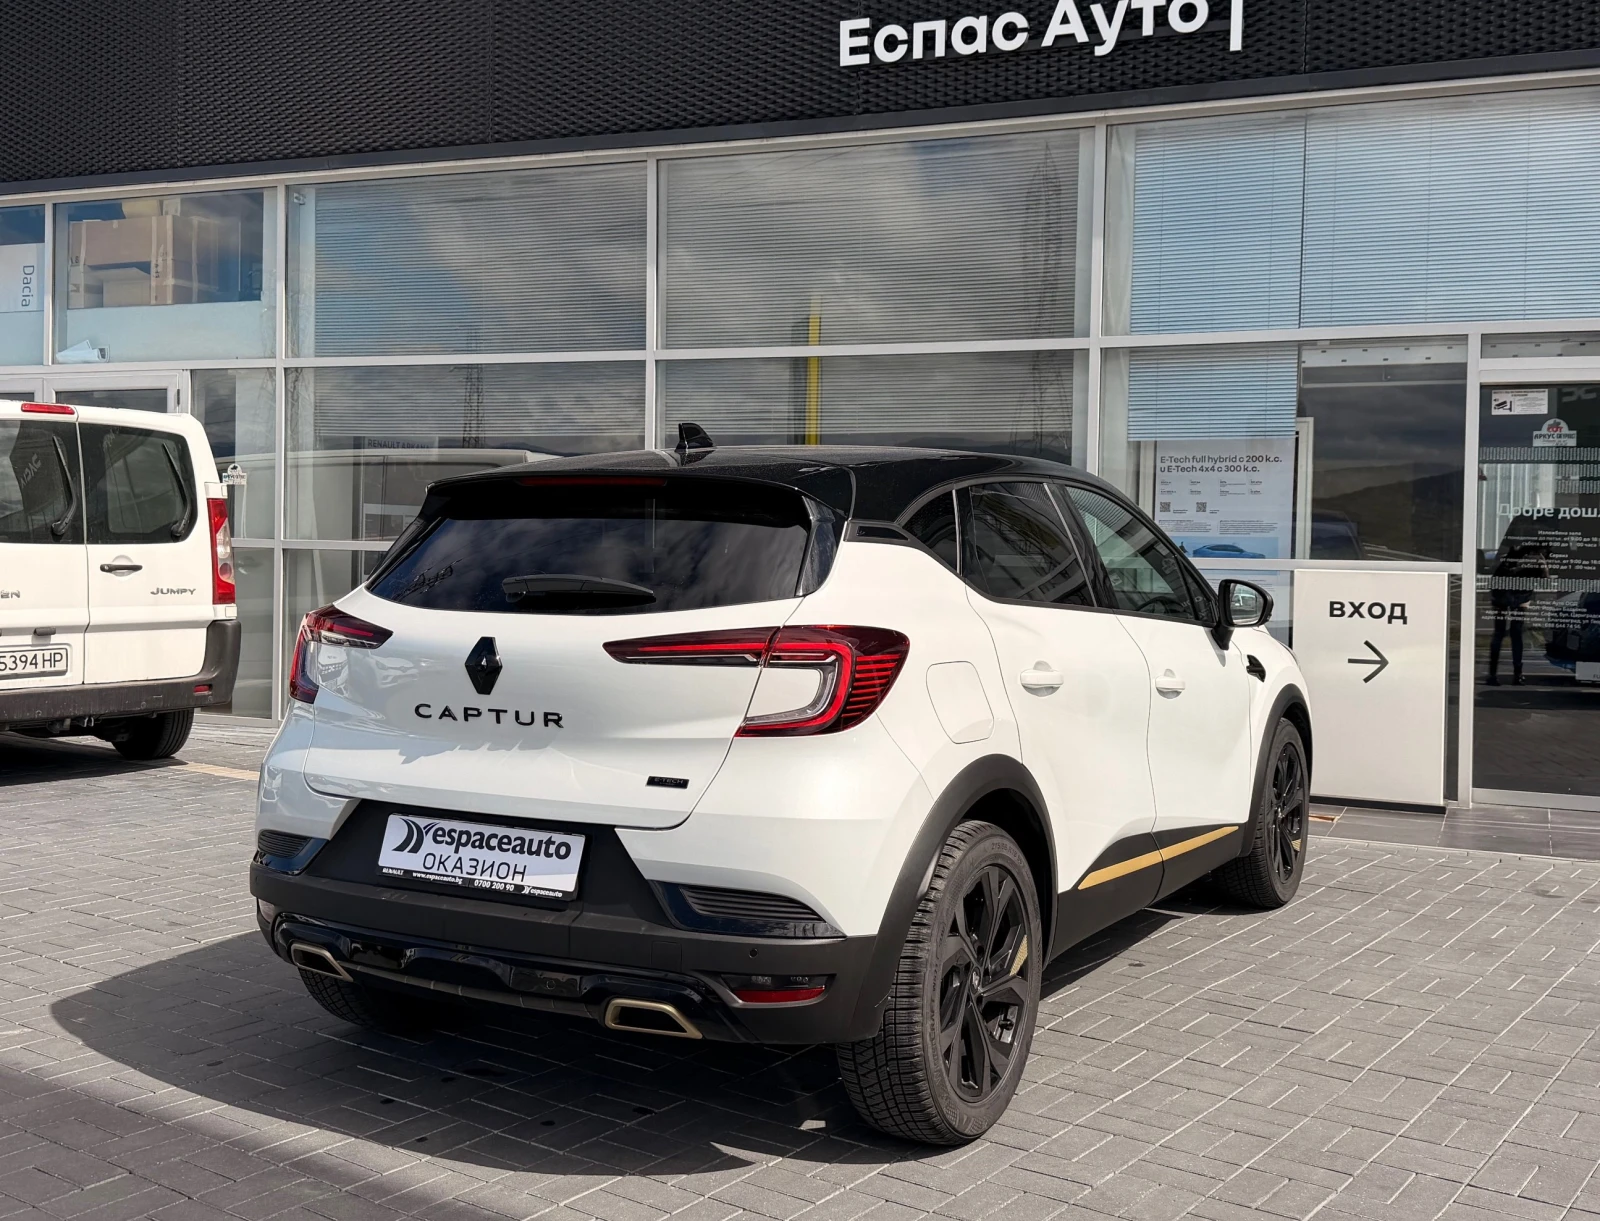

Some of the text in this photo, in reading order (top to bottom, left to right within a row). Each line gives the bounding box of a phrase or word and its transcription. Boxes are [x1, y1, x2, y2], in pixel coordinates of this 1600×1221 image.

[839, 0, 1209, 67] Еспас Ауто
[21, 264, 35, 307] Dacia
[367, 439, 401, 449] RENAULT
[1160, 455, 1190, 464] E-Tech
[1191, 455, 1206, 463] full
[1208, 455, 1237, 465] hybrid
[1245, 455, 1264, 463] 200
[1167, 465, 1198, 473] E-Tech
[1198, 465, 1215, 473] 4x4
[1224, 465, 1242, 473] 300
[1499, 504, 1554, 520] Добре
[150, 587, 196, 596] JUMPY
[1329, 600, 1408, 625] ВХОД
[0, 652, 63, 671] 5394 HP
[414, 703, 564, 728] CAPTUR
[431, 825, 572, 860] espaceauto
[422, 852, 527, 883] ОКАЗИОН
[412, 871, 463, 885] www.espaceauto.bg
[474, 879, 490, 889] 0700
[491, 881, 505, 890] 200
[505, 883, 515, 892] 90
